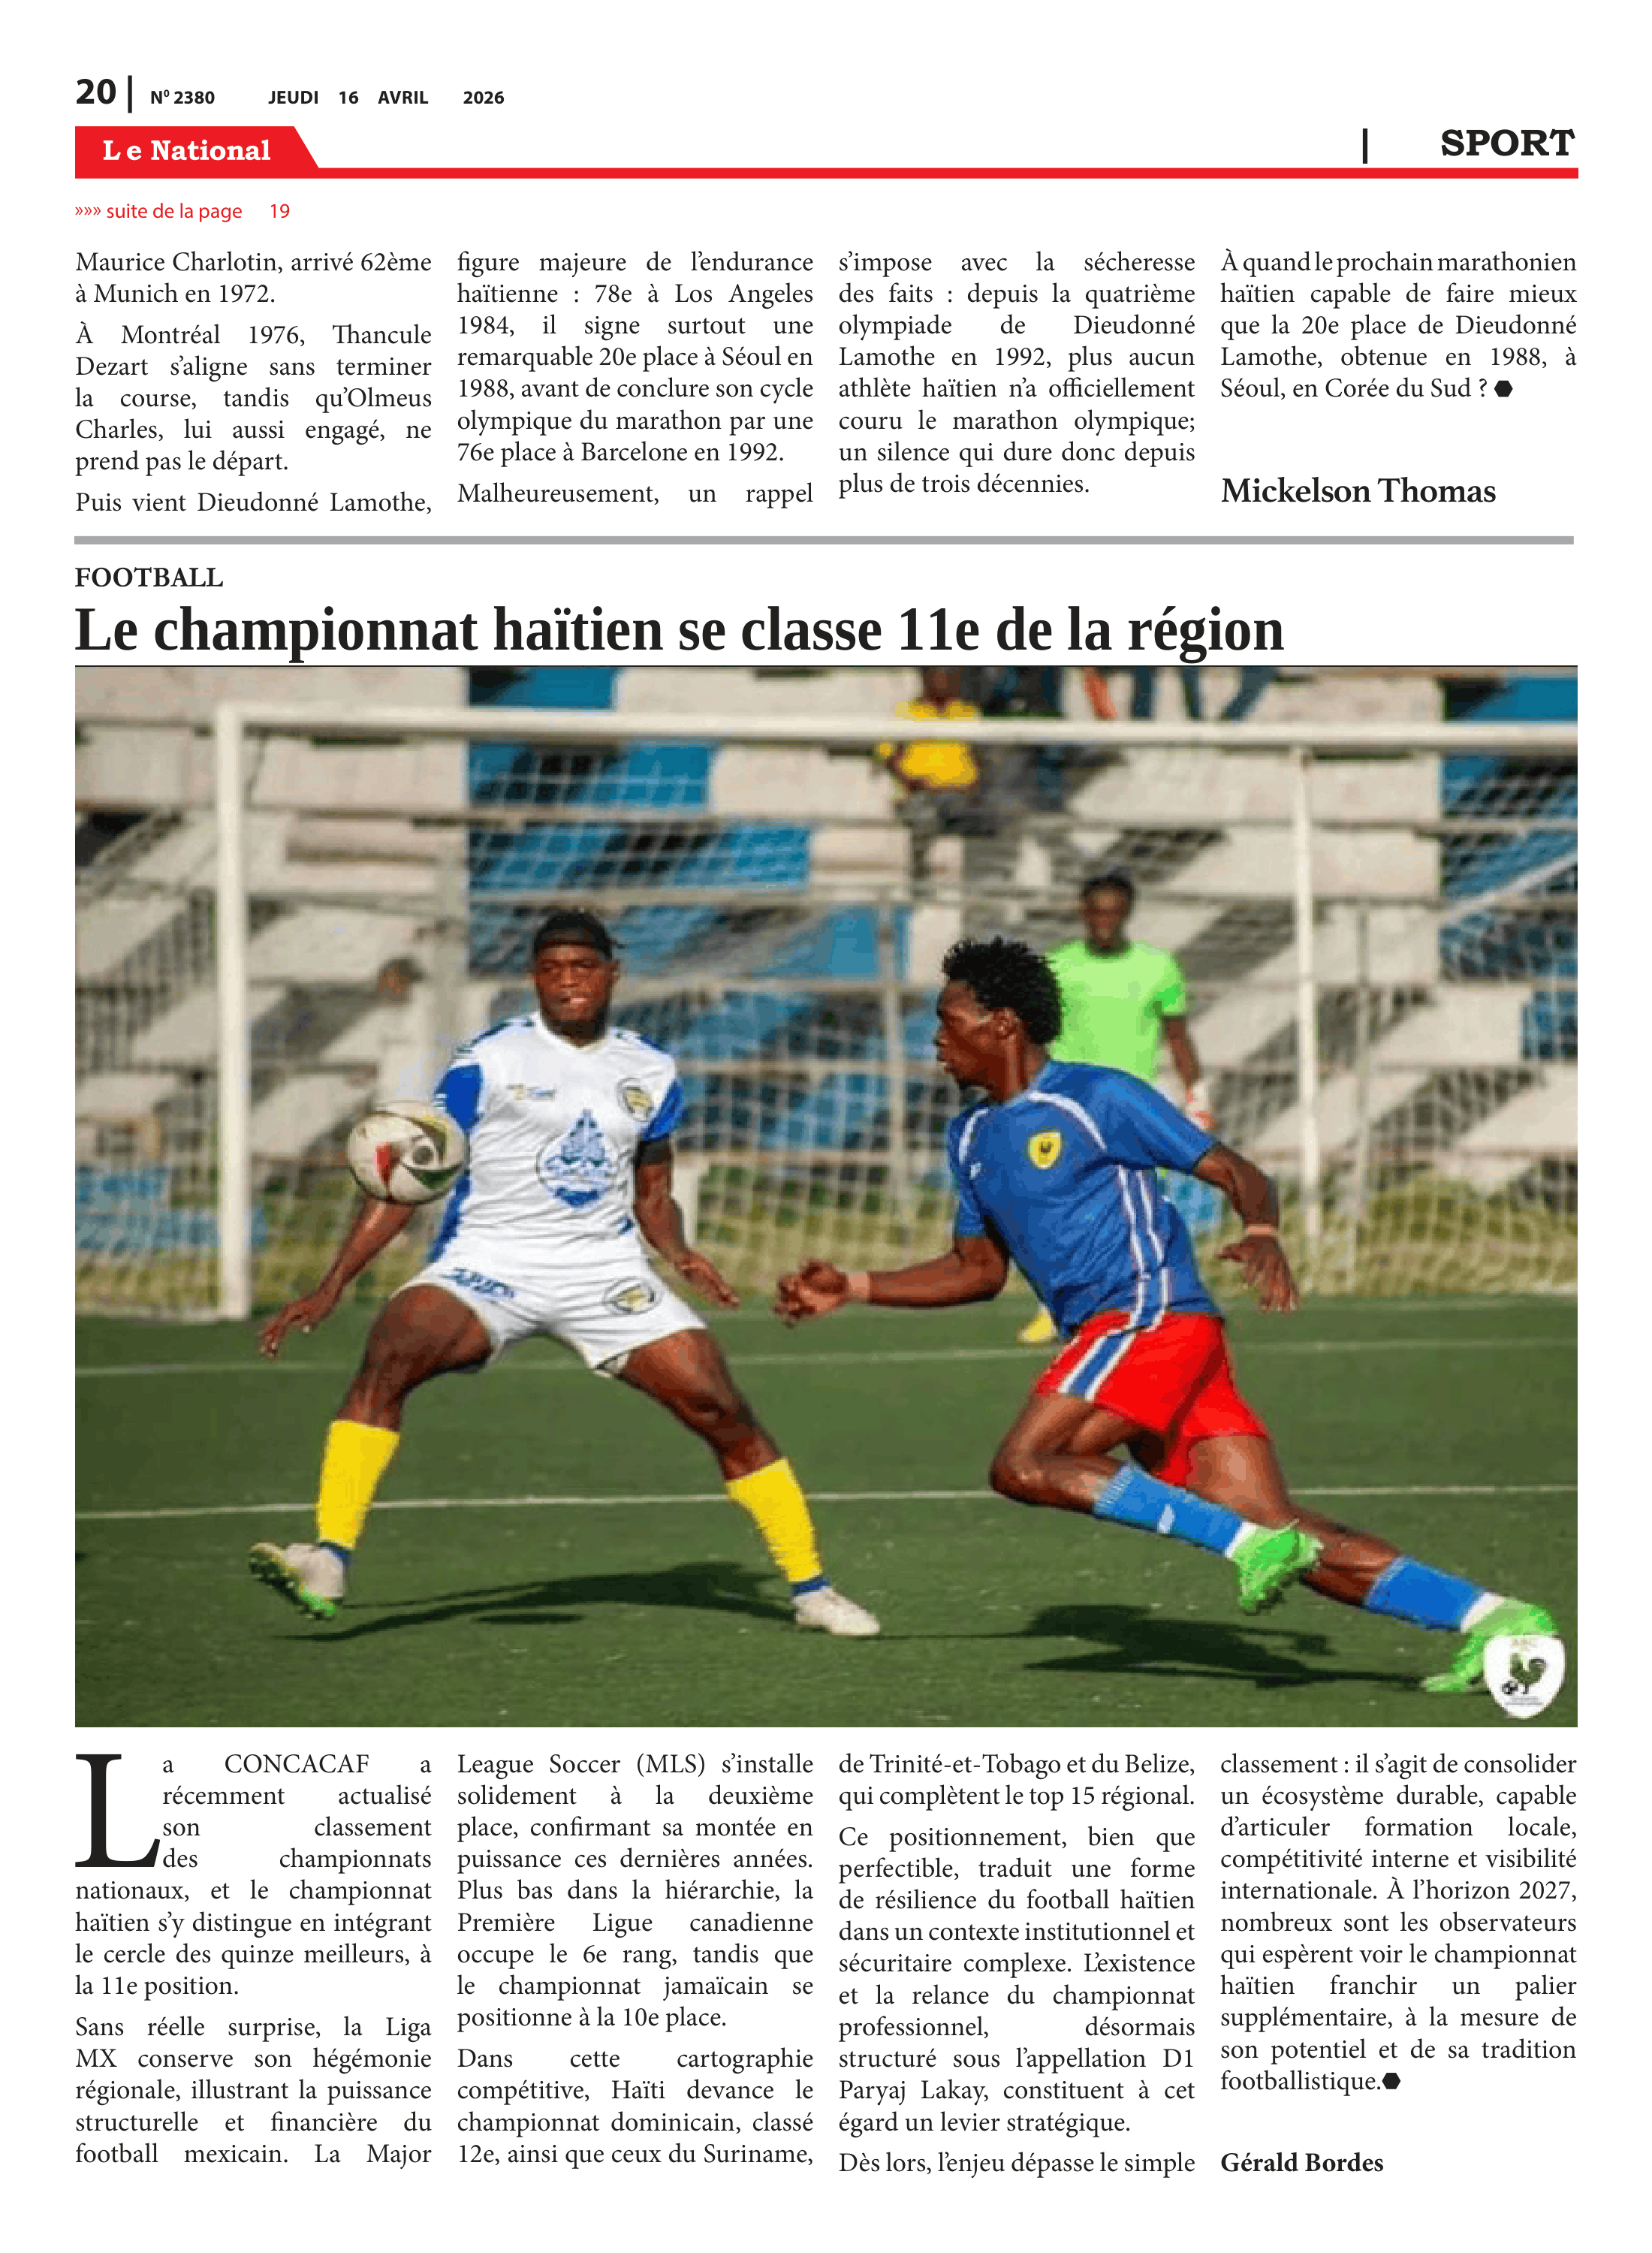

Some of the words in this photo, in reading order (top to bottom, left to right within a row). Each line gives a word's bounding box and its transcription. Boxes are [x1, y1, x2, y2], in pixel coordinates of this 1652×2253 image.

[77, 79, 116, 104] 20
[174, 91, 215, 104] 2380
[269, 91, 318, 104] JEUDI
[339, 91, 358, 104] 16
[378, 91, 428, 104] AVRIL
[464, 91, 504, 104] 2026
[151, 139, 270, 160] National
[1442, 129, 1575, 156] SPORT
[107, 204, 147, 218] suite
[153, 203, 173, 218] de
[181, 203, 193, 218] la
[200, 207, 242, 222] page
[271, 204, 289, 218] 19
[76, 284, 87, 303] à
[94, 282, 178, 303] Munich
[185, 290, 211, 303] en
[220, 285, 274, 303] 1972.
[840, 314, 951, 340] olympiade
[1001, 314, 1025, 334] de
[1074, 314, 1195, 334] Dieudonné
[1221, 321, 1259, 340] que
[1271, 314, 1290, 334] la
[1302, 316, 1339, 334] 20e
[1351, 314, 1406, 340] place
[1418, 314, 1443, 334] de
[1456, 314, 1576, 334] Dieudonné
[458, 345, 592, 372] remarquable
[600, 348, 636, 366] 20e
[643, 345, 698, 372] place
[705, 347, 716, 365] à
[723, 345, 781, 366] Séoul
[788, 353, 813, 366] en
[75, 387, 94, 407] la
[121, 394, 196, 409] course,
[224, 387, 288, 407] tandis
[316, 387, 431, 413] qu’Olmeus
[458, 409, 571, 436] olympique
[580, 409, 607, 430] du
[616, 409, 722, 430] marathon
[730, 417, 765, 436] par
[773, 417, 813, 430] une
[840, 417, 903, 430] couru
[918, 409, 936, 430] le
[953, 409, 1058, 430] marathon
[1075, 409, 1194, 436] olympique;
[457, 482, 659, 505] Malheureusement,
[689, 490, 716, 502] un
[746, 482, 813, 508] rappel
[839, 472, 882, 499] plus
[891, 472, 915, 493] de
[922, 475, 969, 493] trois
[978, 472, 1089, 493] décennies.
[1222, 477, 1371, 502] Mickelson
[1378, 477, 1496, 502] Thomas
[76, 493, 121, 511] Puis
[132, 493, 186, 511] vient
[197, 491, 318, 511] Dieudonné
[330, 491, 431, 514] Lamothe,
[75, 567, 223, 587] FOOTBALL
[75, 608, 137, 650] Le
[155, 606, 478, 663] championnat
[494, 606, 663, 650] haïtien
[680, 620, 725, 650] se
[743, 606, 881, 650] classe
[901, 608, 978, 650] 11e
[997, 606, 1051, 650] de
[1068, 606, 1111, 650] la
[1129, 606, 1284, 663] région
[163, 1786, 285, 1805] récemment
[339, 1784, 431, 1805] actualisé
[458, 1784, 577, 1805] solidement
[611, 1786, 622, 1804] à
[656, 1784, 674, 1804] la
[709, 1784, 813, 1805] deuxième
[840, 1787, 873, 1811] qui
[880, 1784, 1000, 1811] complètent
[1005, 1784, 1023, 1805] le
[1029, 1788, 1063, 1811] top
[1072, 1787, 1094, 1805] 15
[1102, 1784, 1194, 1811] régional.
[1221, 1792, 1249, 1805] un
[1262, 1786, 1383, 1811] écosystème
[1397, 1784, 1483, 1807] durable,
[1497, 1784, 1576, 1811] capable
[163, 1823, 200, 1836] son
[315, 1816, 432, 1836] classement
[457, 1850, 561, 1874] puissance
[575, 1855, 606, 1868] ces
[620, 1847, 719, 1868] dernières
[734, 1849, 812, 1868] années.
[1221, 1849, 1362, 1874] compétitivité
[1372, 1850, 1449, 1868] interne
[1458, 1851, 1477, 1868] et
[1485, 1847, 1576, 1868] visibilité
[840, 1889, 864, 1909] de
[876, 1889, 976, 1909] résilience
[988, 1889, 1015, 1909] du
[1026, 1889, 1109, 1909] football
[1120, 1889, 1195, 1909] haïtien
[458, 1913, 555, 1932] Première
[593, 1913, 653, 1938] Ligue
[690, 1911, 813, 1932] canadienne
[75, 1943, 93, 1963] le
[104, 1943, 165, 1963] cercle
[176, 1943, 210, 1963] des
[222, 1945, 294, 1969] quinze
[304, 1943, 409, 1965] meilleurs,
[421, 1944, 432, 1963] à
[840, 1953, 951, 1972] sécuritaire
[964, 1952, 1071, 1978] complexe.
[1084, 1952, 1195, 1972] L’existence
[1221, 1945, 1256, 1969] qui
[1263, 1944, 1353, 1969] espèrent
[1359, 1945, 1403, 1963] voir
[1409, 1943, 1427, 1963] le
[1435, 1943, 1577, 1969] championnat
[457, 1974, 475, 1995] le
[499, 1974, 641, 2001] championnat
[663, 1977, 768, 2001] jamaïcain
[793, 1982, 813, 1995] se
[839, 2016, 988, 2042] professionnel,
[1086, 2016, 1195, 2036] désormais
[76, 2049, 117, 2067] MX
[138, 2055, 233, 2068] conserve
[255, 2055, 292, 2068] son
[313, 2047, 431, 2074] hégémonie
[458, 2049, 512, 2068] Dans
[571, 2051, 620, 2068] cette
[677, 2047, 813, 2074] cartographie
[76, 2111, 198, 2131] structurelle
[225, 2115, 244, 2131] et
[271, 2111, 377, 2131] financière
[404, 2111, 432, 2131] du
[458, 2111, 599, 2137] championnat
[611, 2111, 740, 2134] dominicain,
[753, 2111, 813, 2131] classé
[840, 2111, 898, 2137] égard
[906, 2119, 933, 2131] un
[940, 2111, 1000, 2131] levier
[1007, 2113, 1129, 2137] stratégique.
[1221, 2152, 1298, 2172] Gérald
[1305, 2152, 1383, 2172] Bordes
